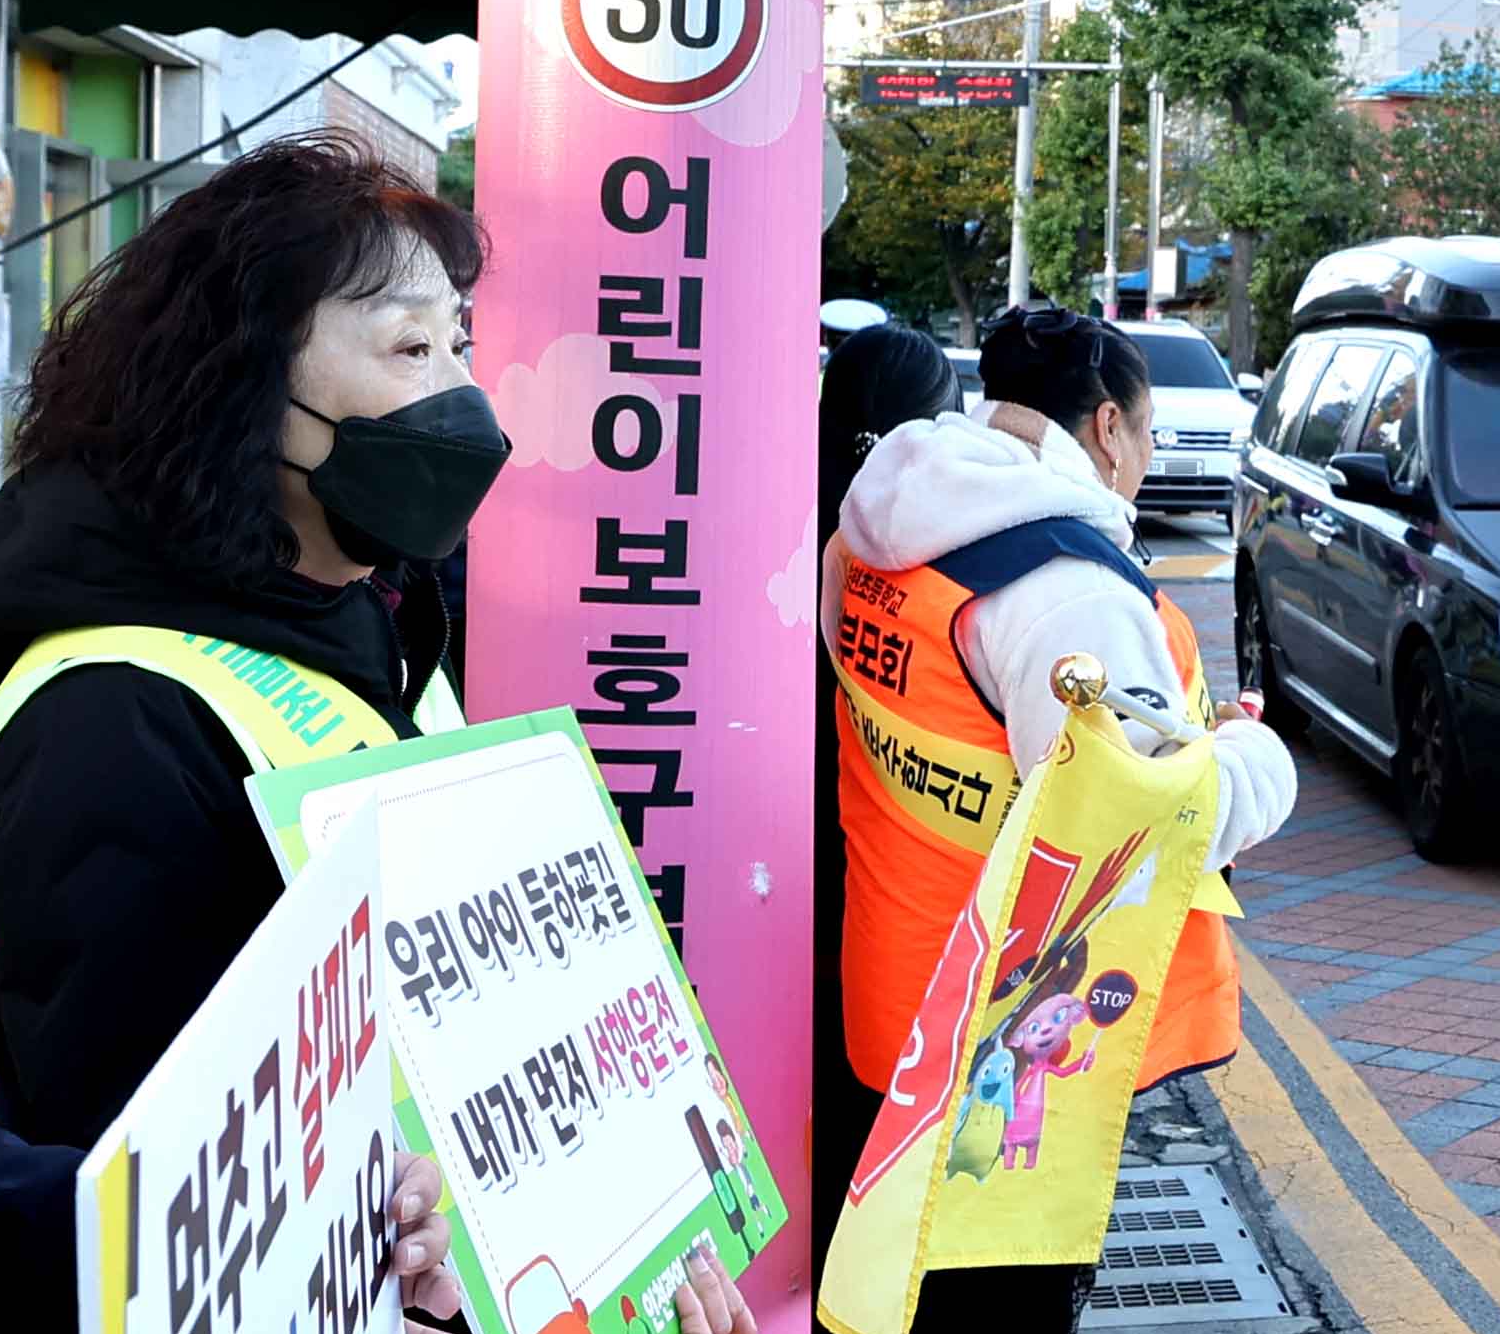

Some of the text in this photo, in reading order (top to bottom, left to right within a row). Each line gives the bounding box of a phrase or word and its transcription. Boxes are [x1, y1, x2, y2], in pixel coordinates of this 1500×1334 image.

[845, 563, 909, 619] 현초등학교
[385, 839, 633, 1021] 우리 아이 등하굣길
[291, 893, 377, 1205] 살피고
[1090, 987, 1132, 1009] STOP
[452, 974, 694, 1186] 내가 먼저 서행운전
[641, 1246, 690, 1334] 인천광역
